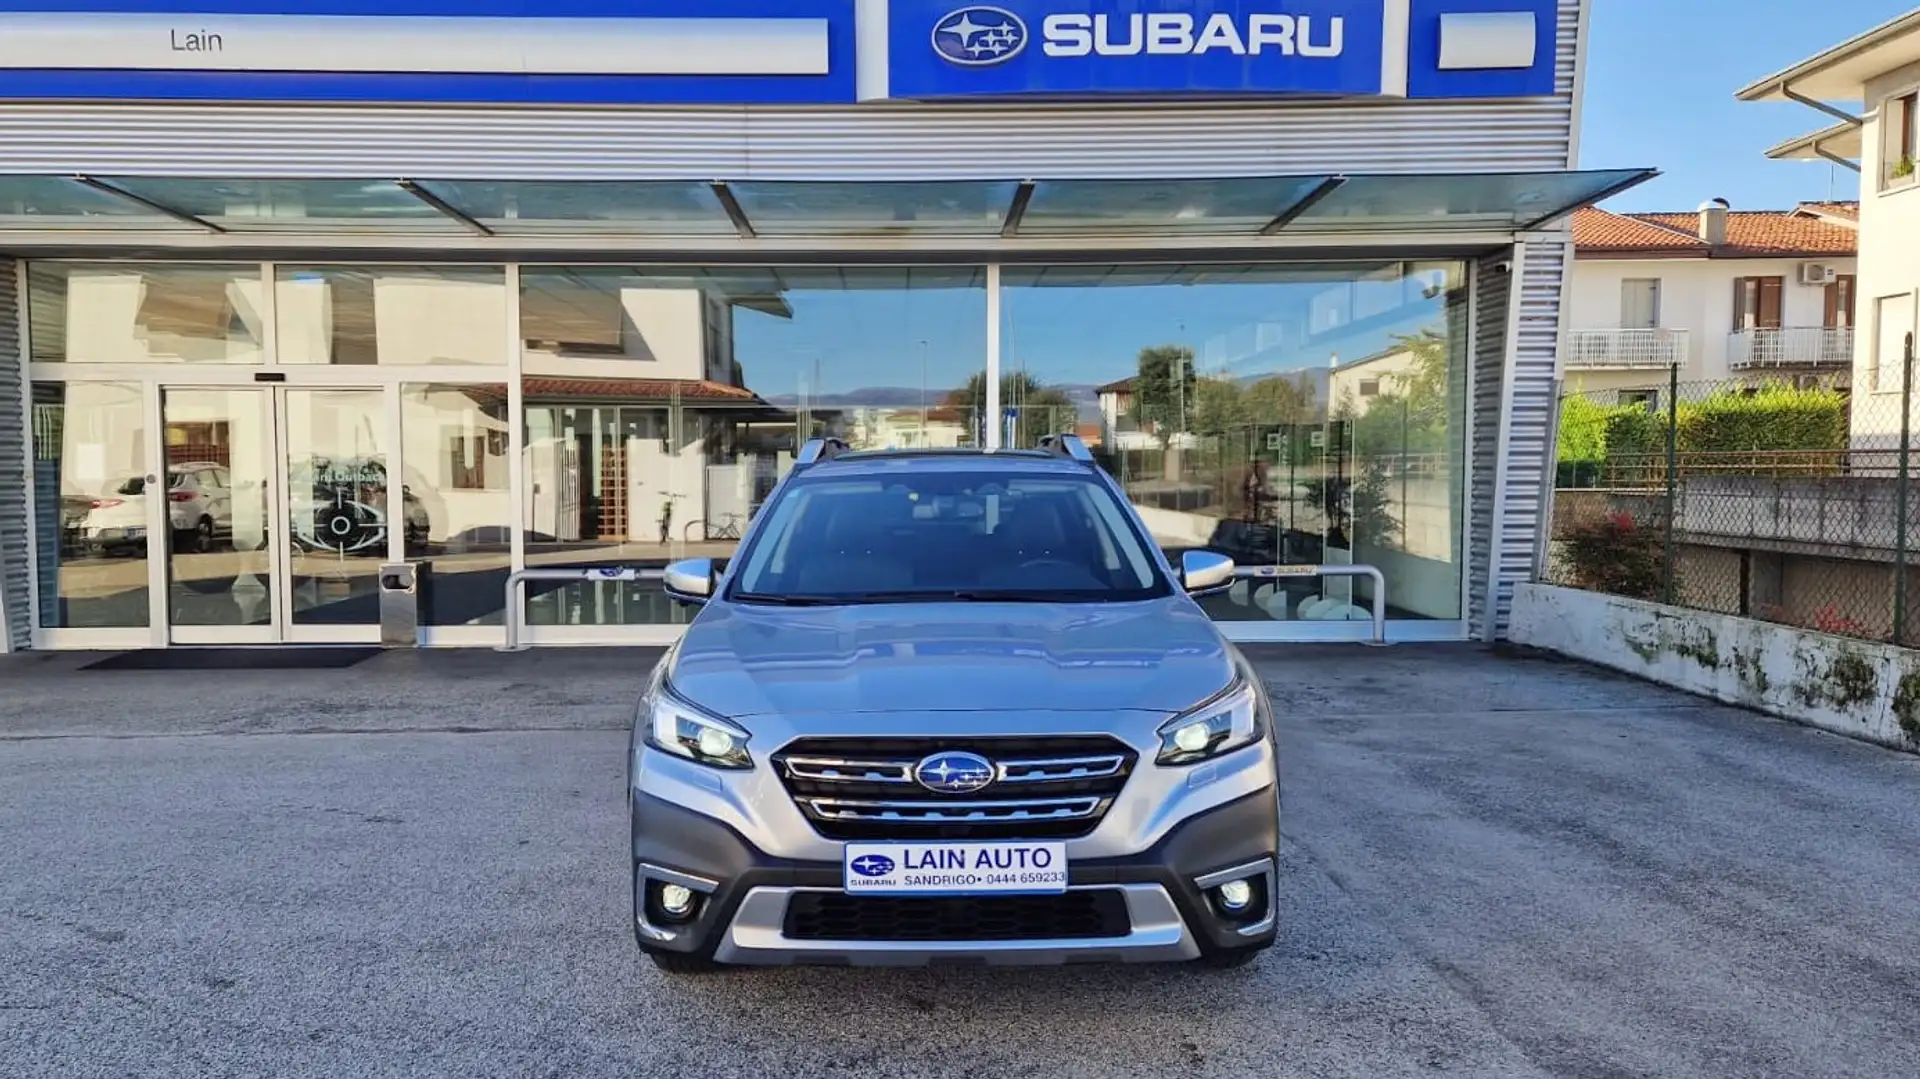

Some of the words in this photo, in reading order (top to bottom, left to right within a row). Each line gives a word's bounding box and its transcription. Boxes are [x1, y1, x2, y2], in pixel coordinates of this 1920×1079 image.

[171, 28, 222, 52] Lain
[1043, 13, 1343, 57] SUBARU
[904, 849, 965, 869] LAIN
[975, 847, 1052, 869] AUTO
[986, 873, 1016, 884] 0444
[1020, 871, 1065, 883] 659233
